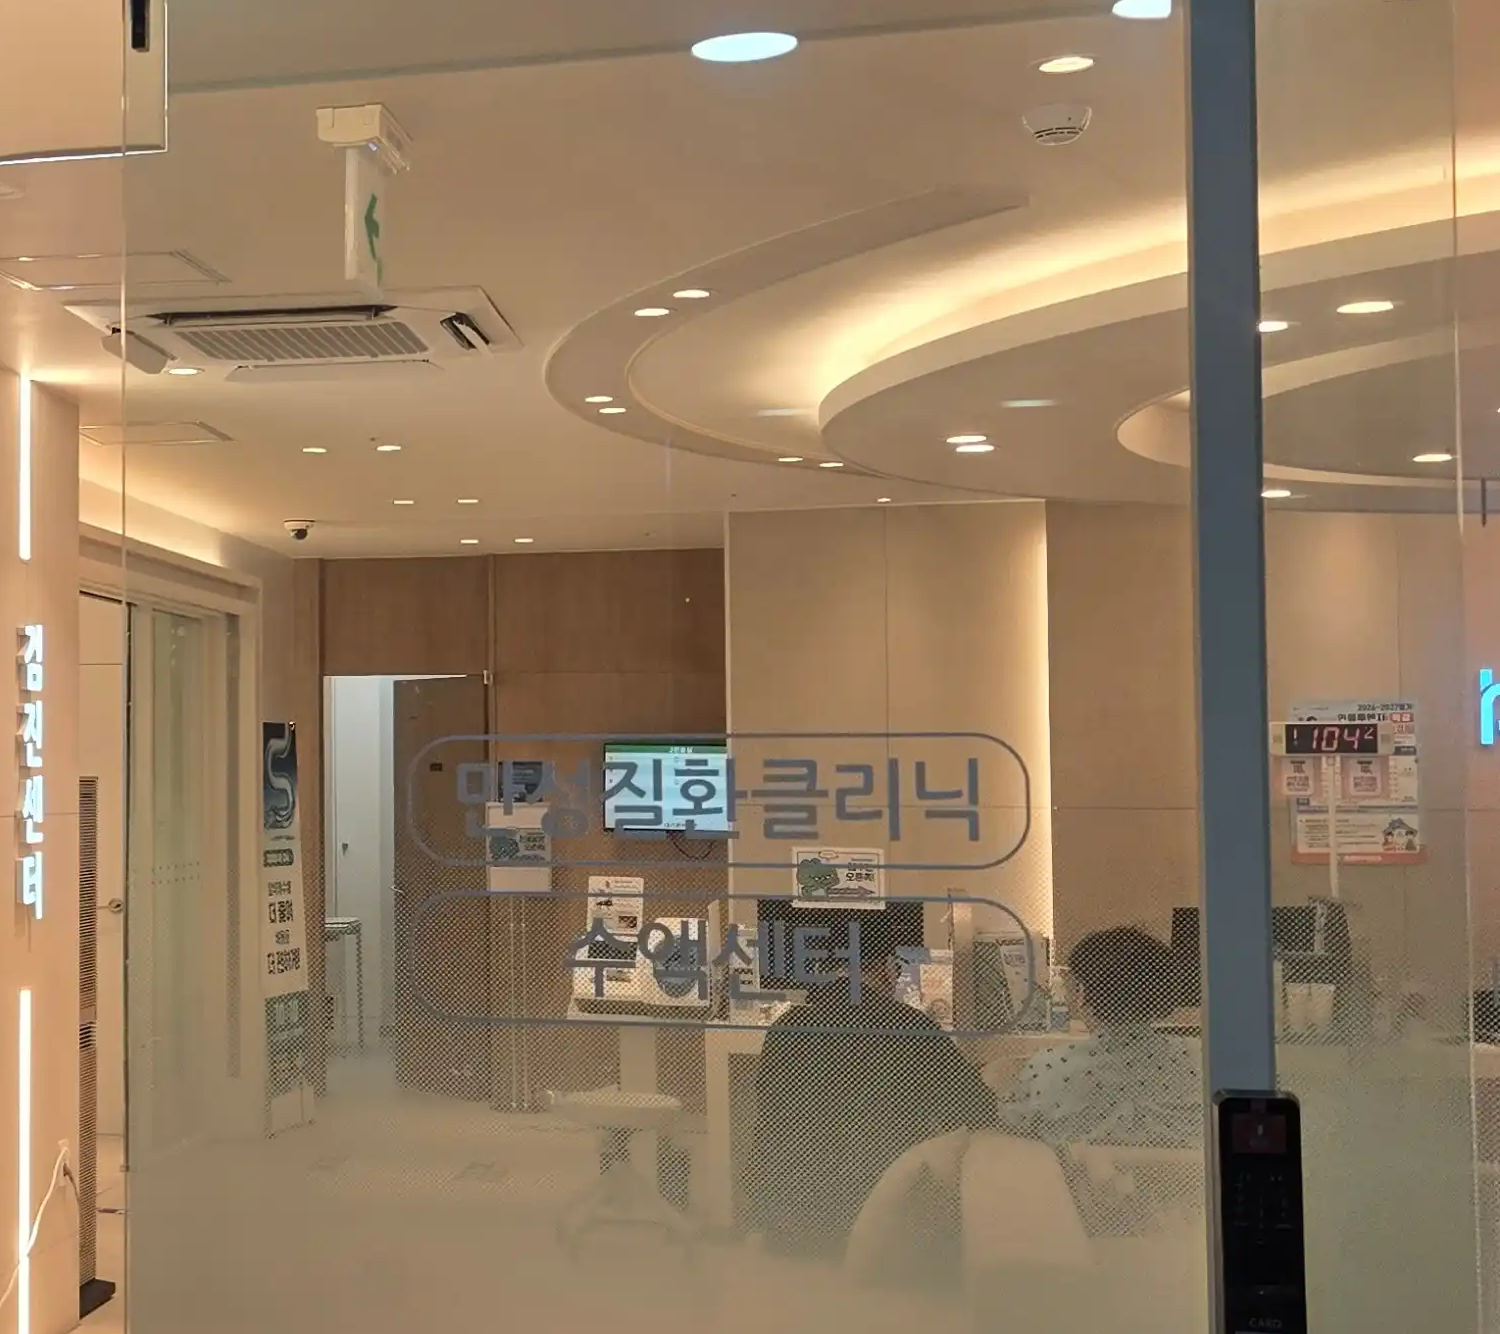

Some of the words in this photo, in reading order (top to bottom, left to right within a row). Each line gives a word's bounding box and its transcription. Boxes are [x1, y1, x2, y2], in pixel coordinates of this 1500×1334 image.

[16, 624, 44, 919] 검진센터
[456, 756, 980, 842] 만성질환클리닉
[561, 916, 864, 1006] 수액센터
